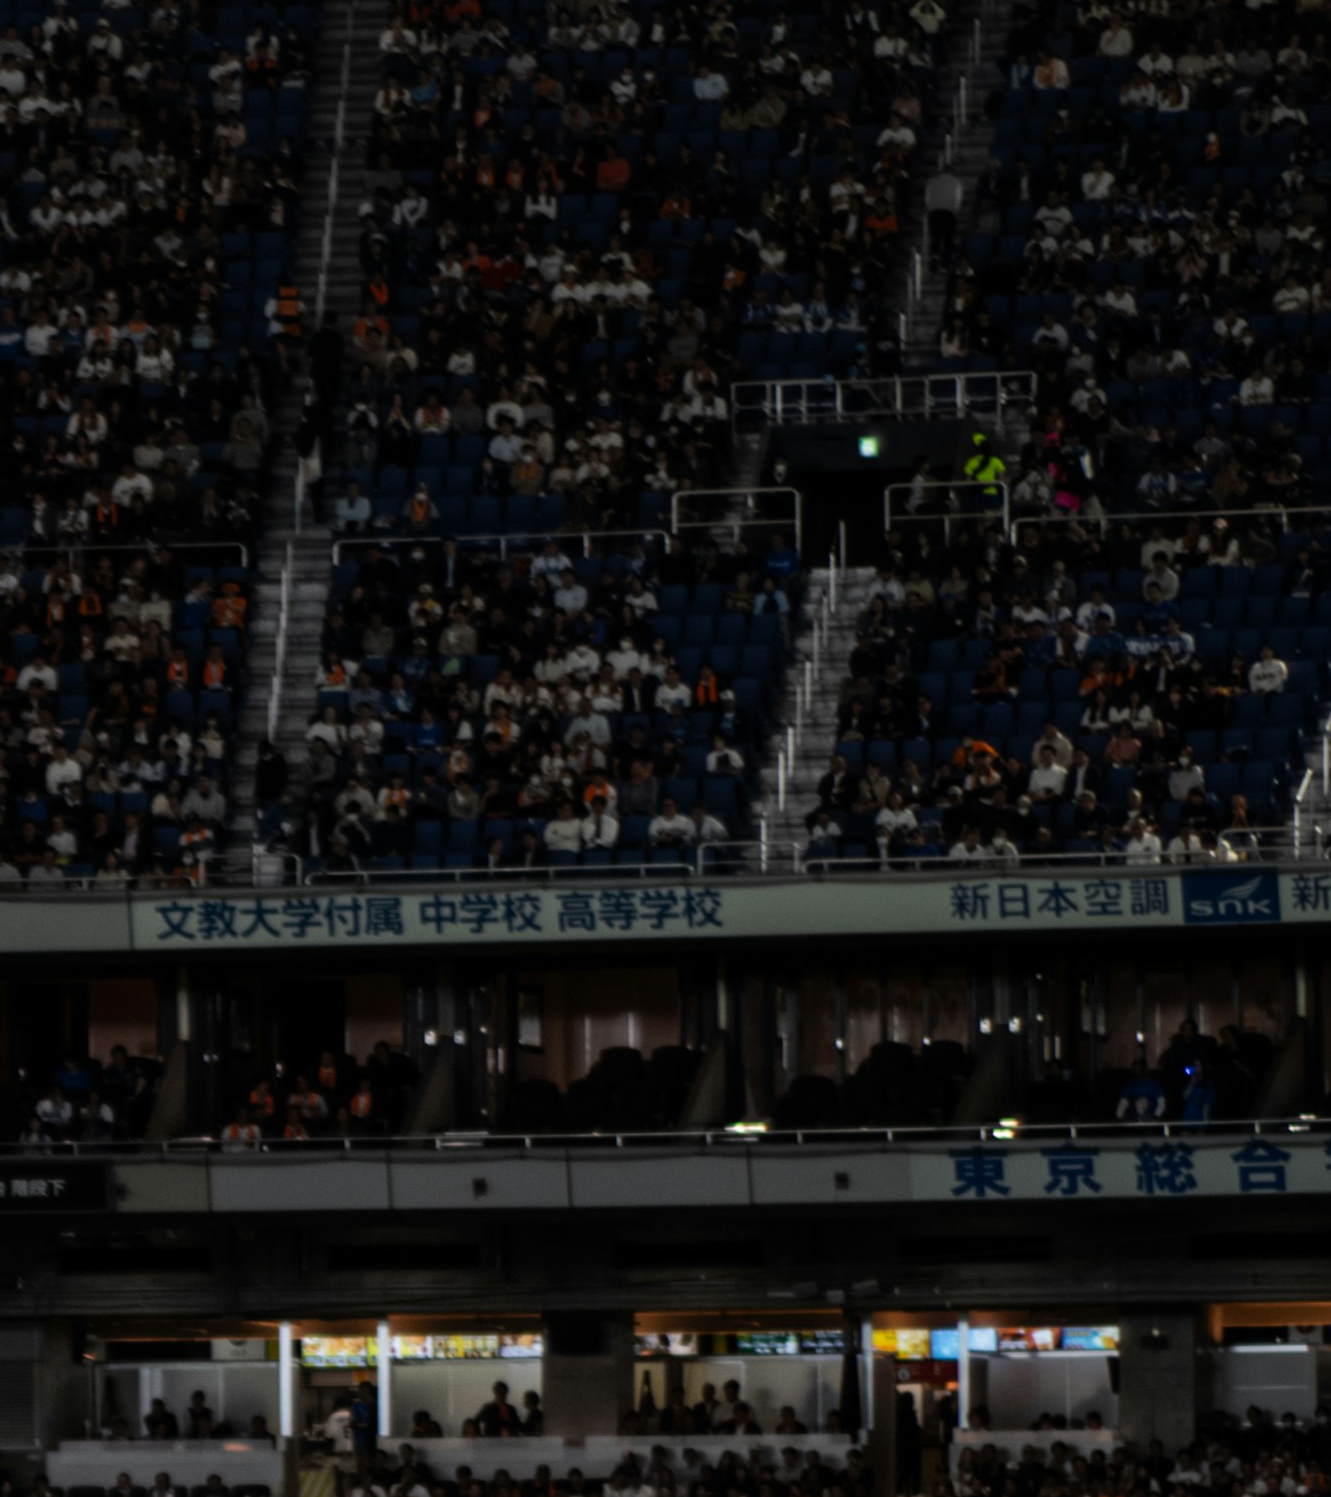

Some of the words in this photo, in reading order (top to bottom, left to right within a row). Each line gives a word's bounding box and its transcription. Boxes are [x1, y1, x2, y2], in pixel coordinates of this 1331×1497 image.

[157, 897, 404, 940] 文教大学付属
[419, 893, 542, 934] 中学校
[557, 888, 723, 932] 高等学校
[950, 879, 1170, 921] 新日本空調
[948, 1140, 1331, 1197] 東京総合
